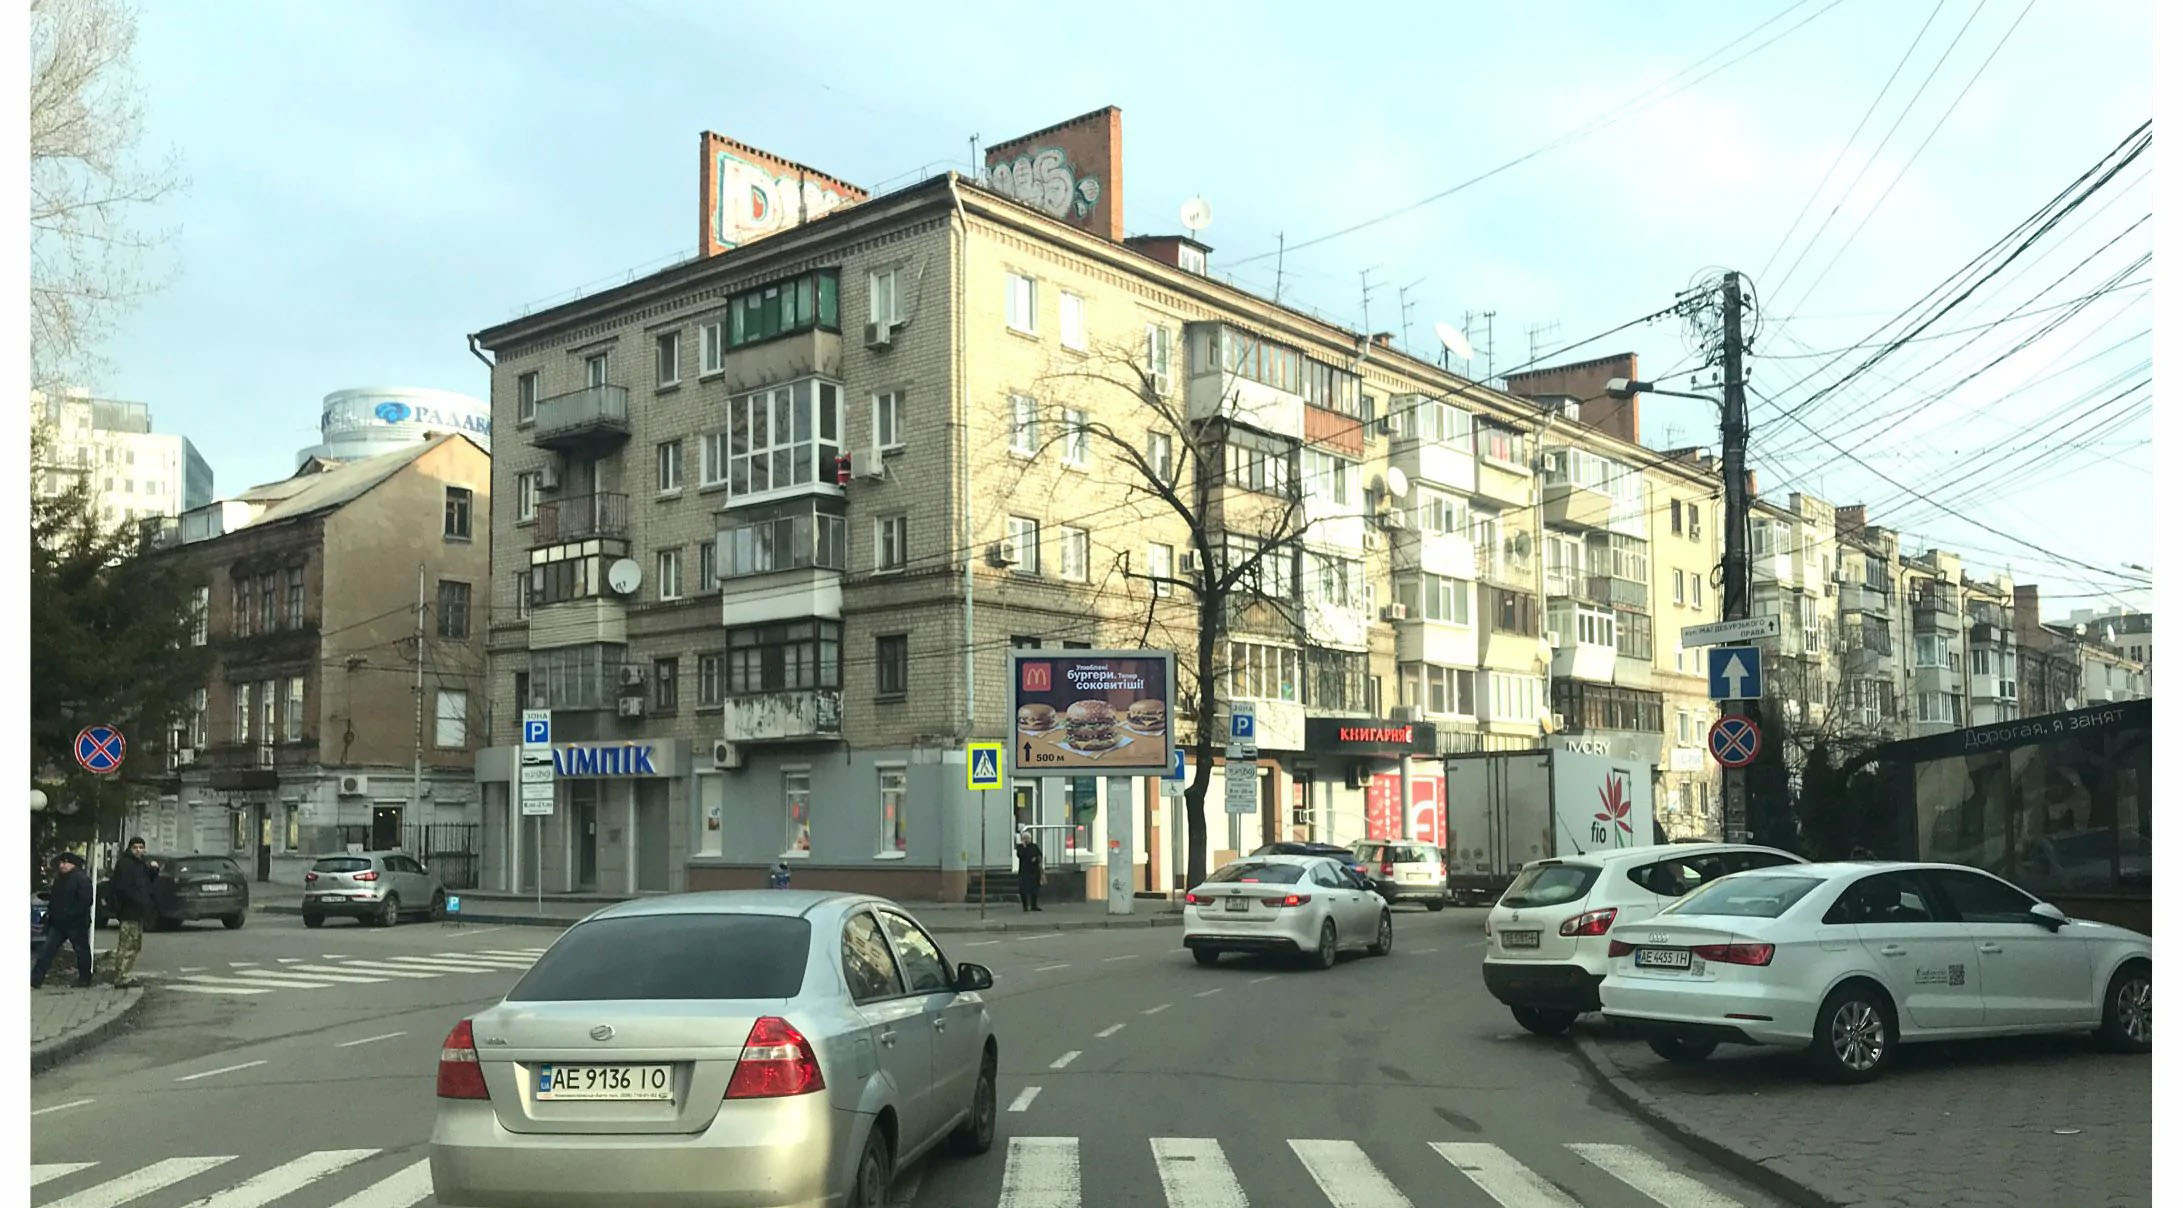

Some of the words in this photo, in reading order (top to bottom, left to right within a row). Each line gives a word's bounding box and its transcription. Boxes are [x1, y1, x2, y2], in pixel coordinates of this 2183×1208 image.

[1740, 628, 1766, 638] ПРАВА
[1067, 669, 1117, 682] бургери.
[1118, 672, 1138, 680] Тепер
[1075, 679, 1144, 690] соковитіші!
[1965, 722, 2048, 749] Дорогая,
[2053, 720, 2064, 732] я
[2069, 709, 2125, 730] занят
[1567, 740, 1611, 755] IVORY
[1037, 753, 1055, 762] 500
[1590, 820, 1607, 844] fio
[1641, 951, 1653, 963] AE
[1654, 952, 1673, 964] 4455
[552, 1068, 580, 1090] AE
[586, 1068, 631, 1090] 9136
